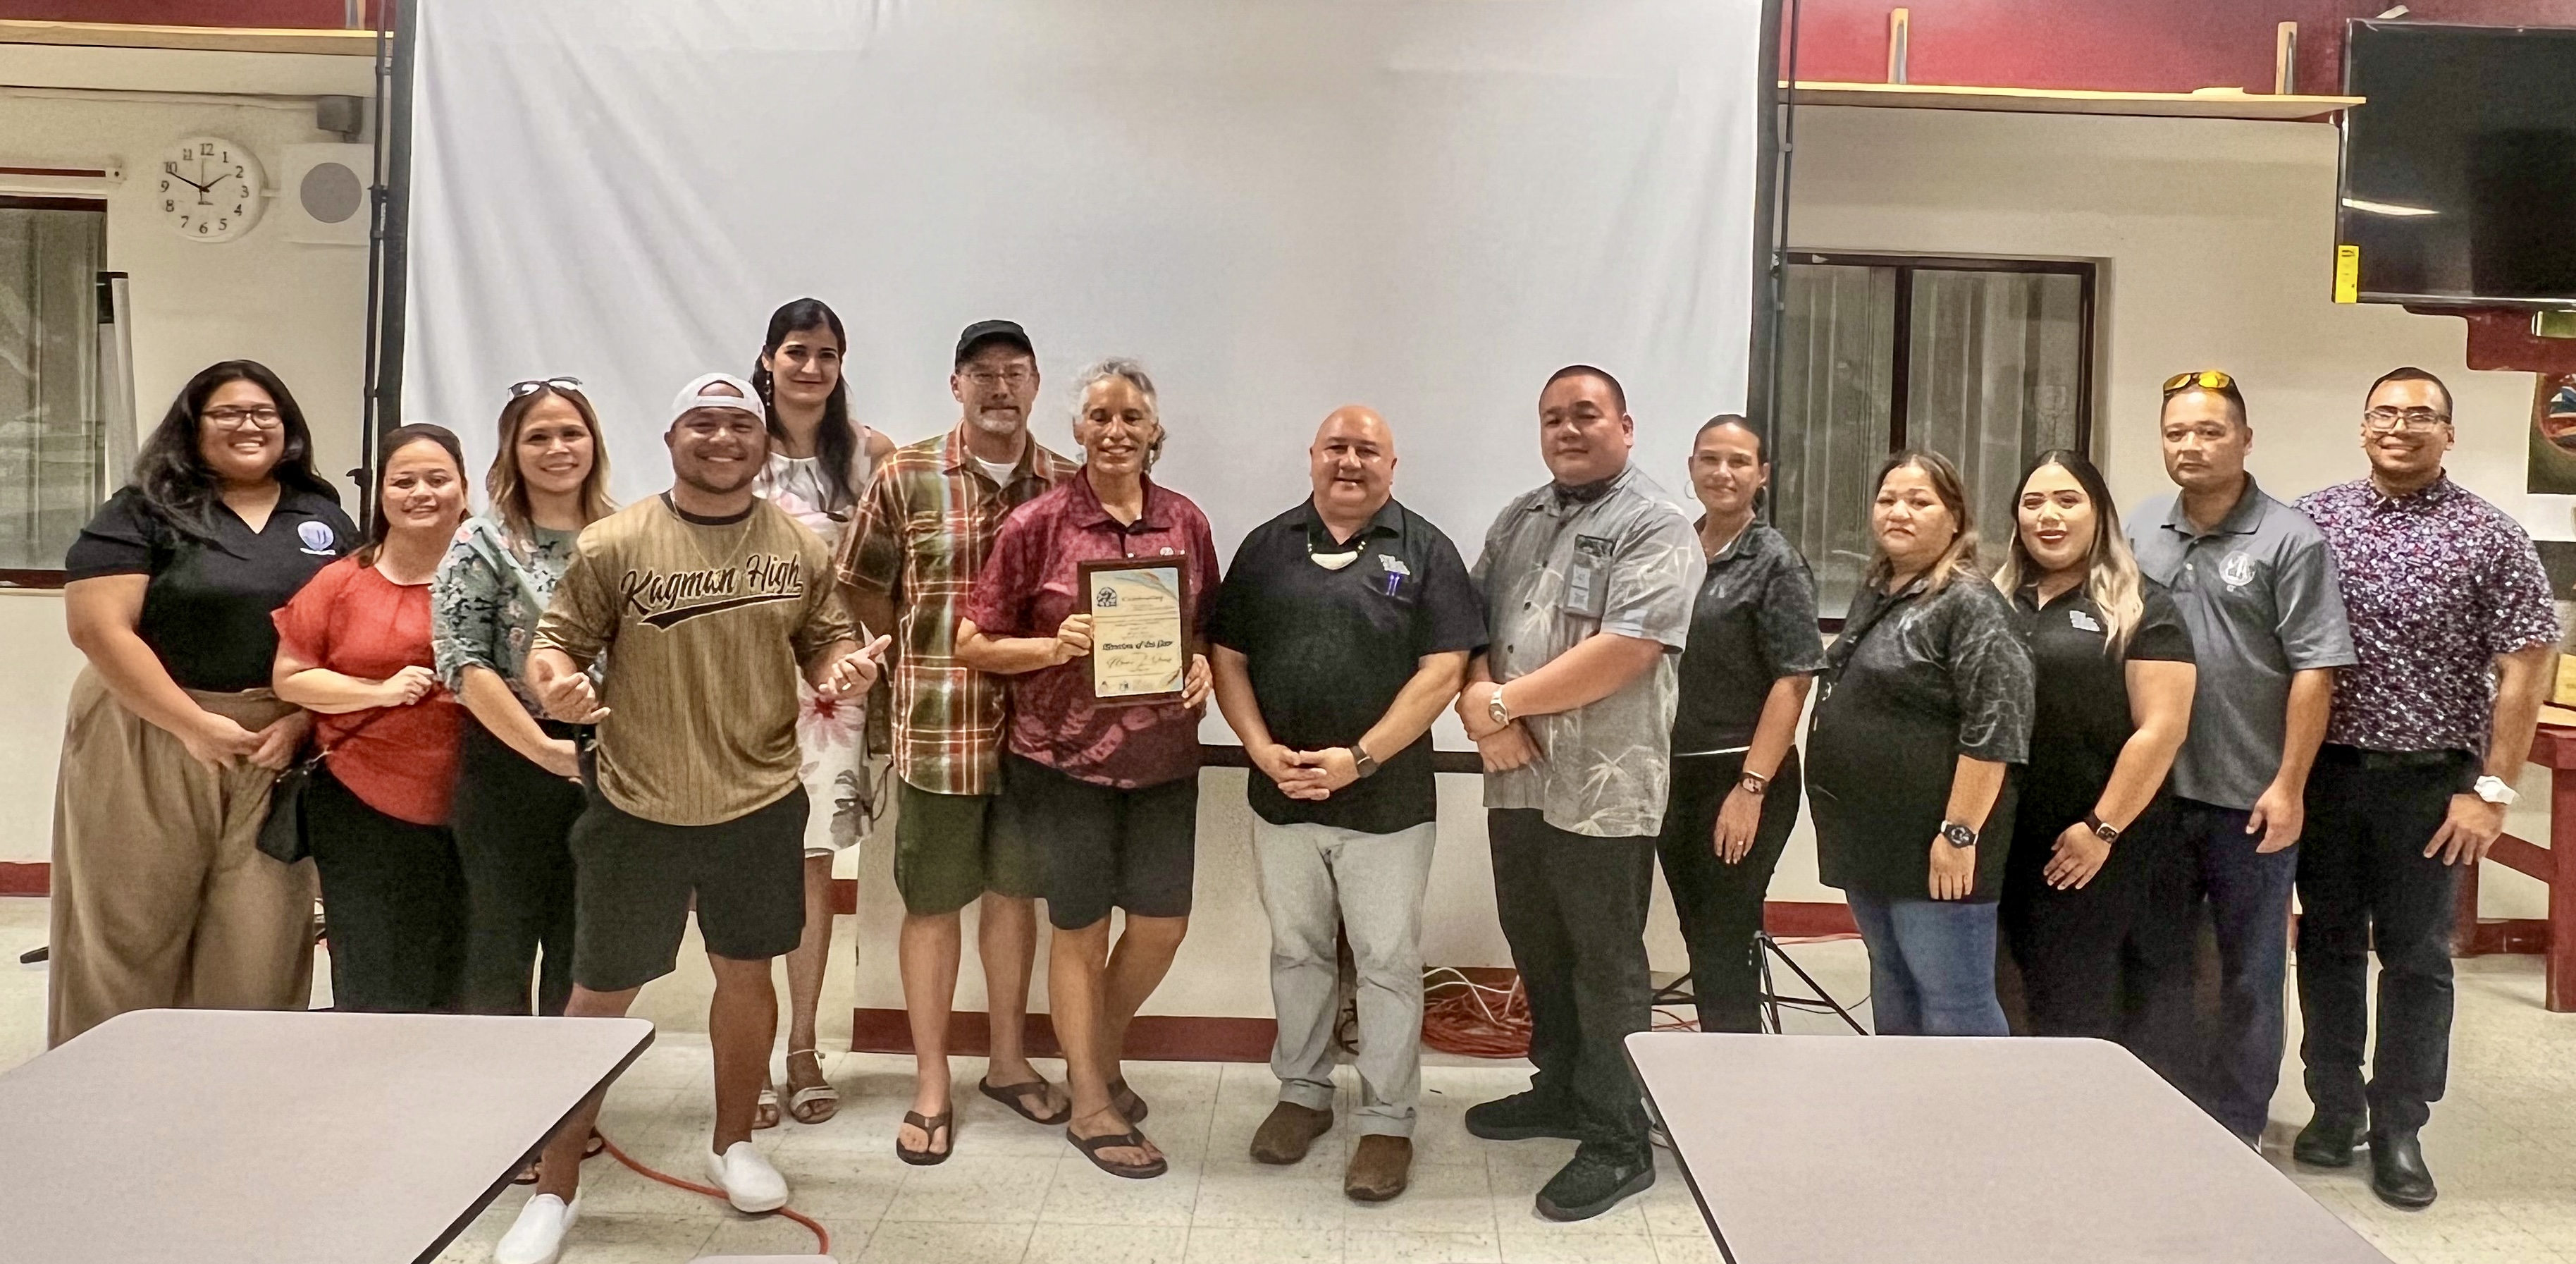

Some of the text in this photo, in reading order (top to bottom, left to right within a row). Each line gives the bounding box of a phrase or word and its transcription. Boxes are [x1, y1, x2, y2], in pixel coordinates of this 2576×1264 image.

[183, 148, 195, 161] 11
[200, 143, 214, 156] 12
[223, 151, 229, 163] 1
[164, 161, 178, 174] 10
[235, 166, 244, 178] 2
[161, 180, 170, 192] 9
[240, 185, 249, 198] 3
[165, 200, 175, 212] 8
[233, 204, 242, 216] 4
[180, 216, 190, 228] 7
[199, 222, 209, 234] 6
[218, 218, 228, 231] 5
[620, 554, 803, 615] Kagman High
